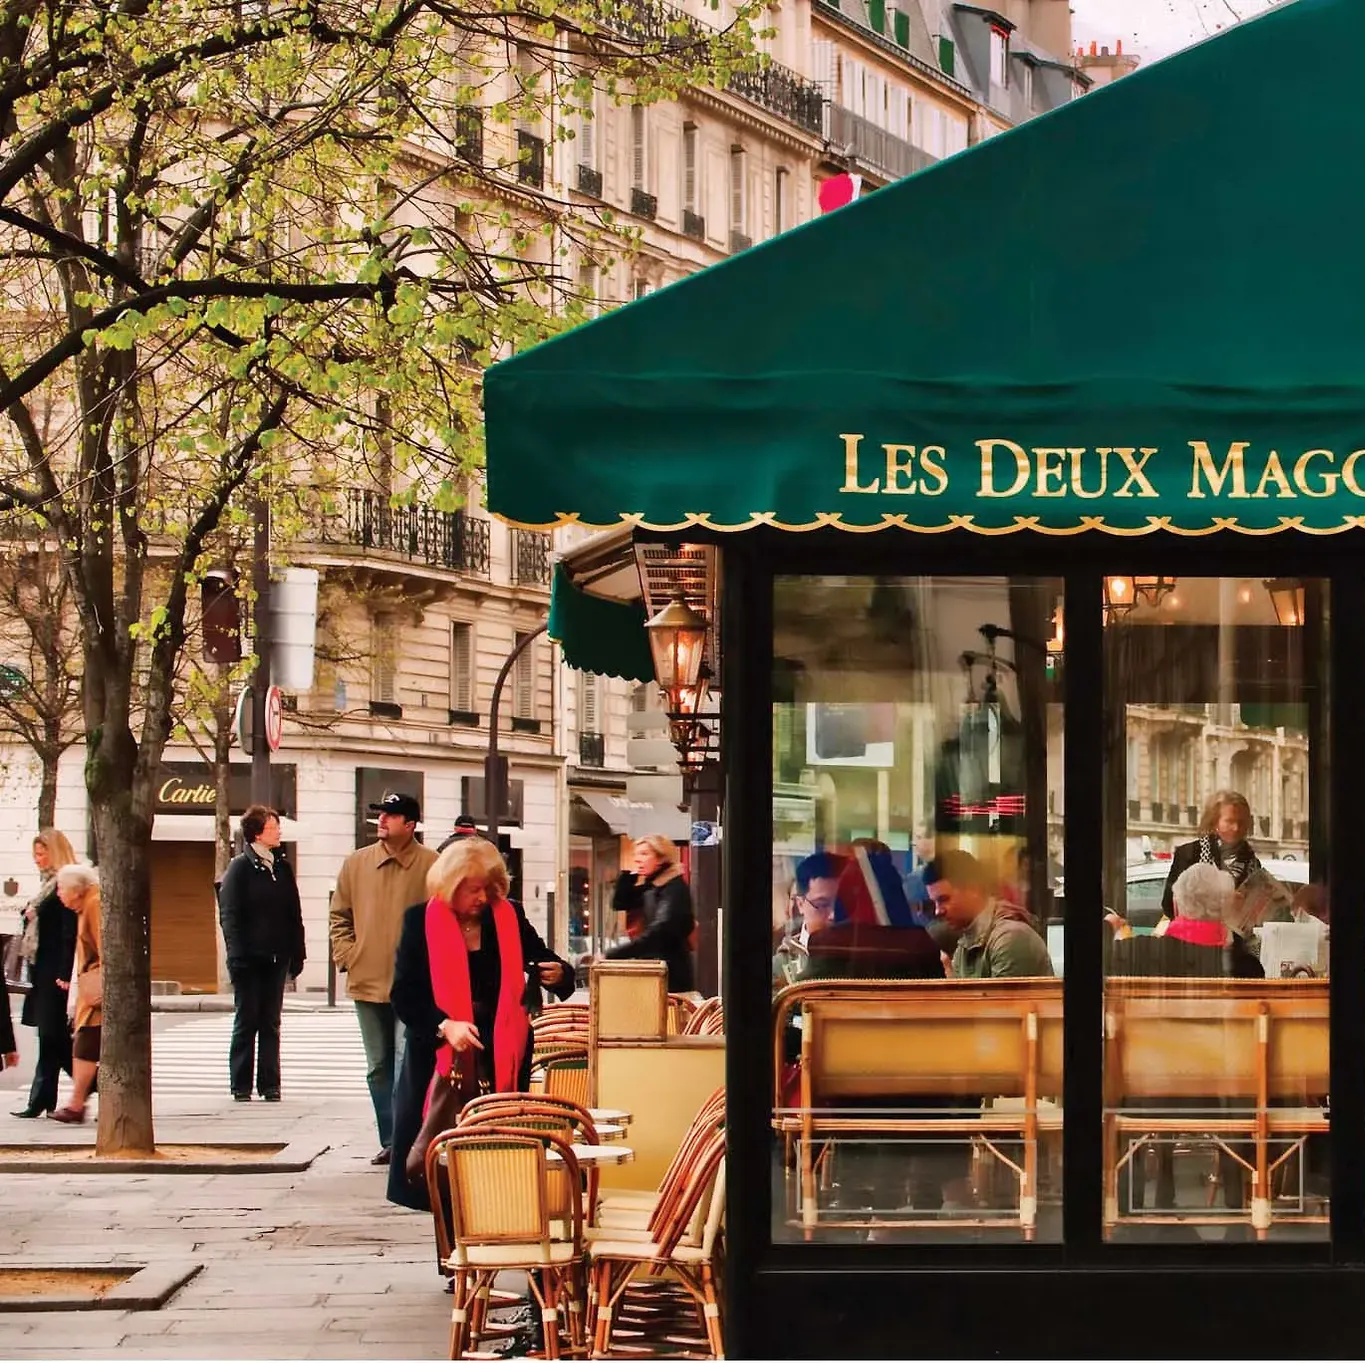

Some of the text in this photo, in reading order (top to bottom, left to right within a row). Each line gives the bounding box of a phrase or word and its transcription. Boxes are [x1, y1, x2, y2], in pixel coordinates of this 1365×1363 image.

[839, 433, 949, 496] LES
[974, 438, 1160, 499] DEUX
[158, 777, 217, 803] Cartie
